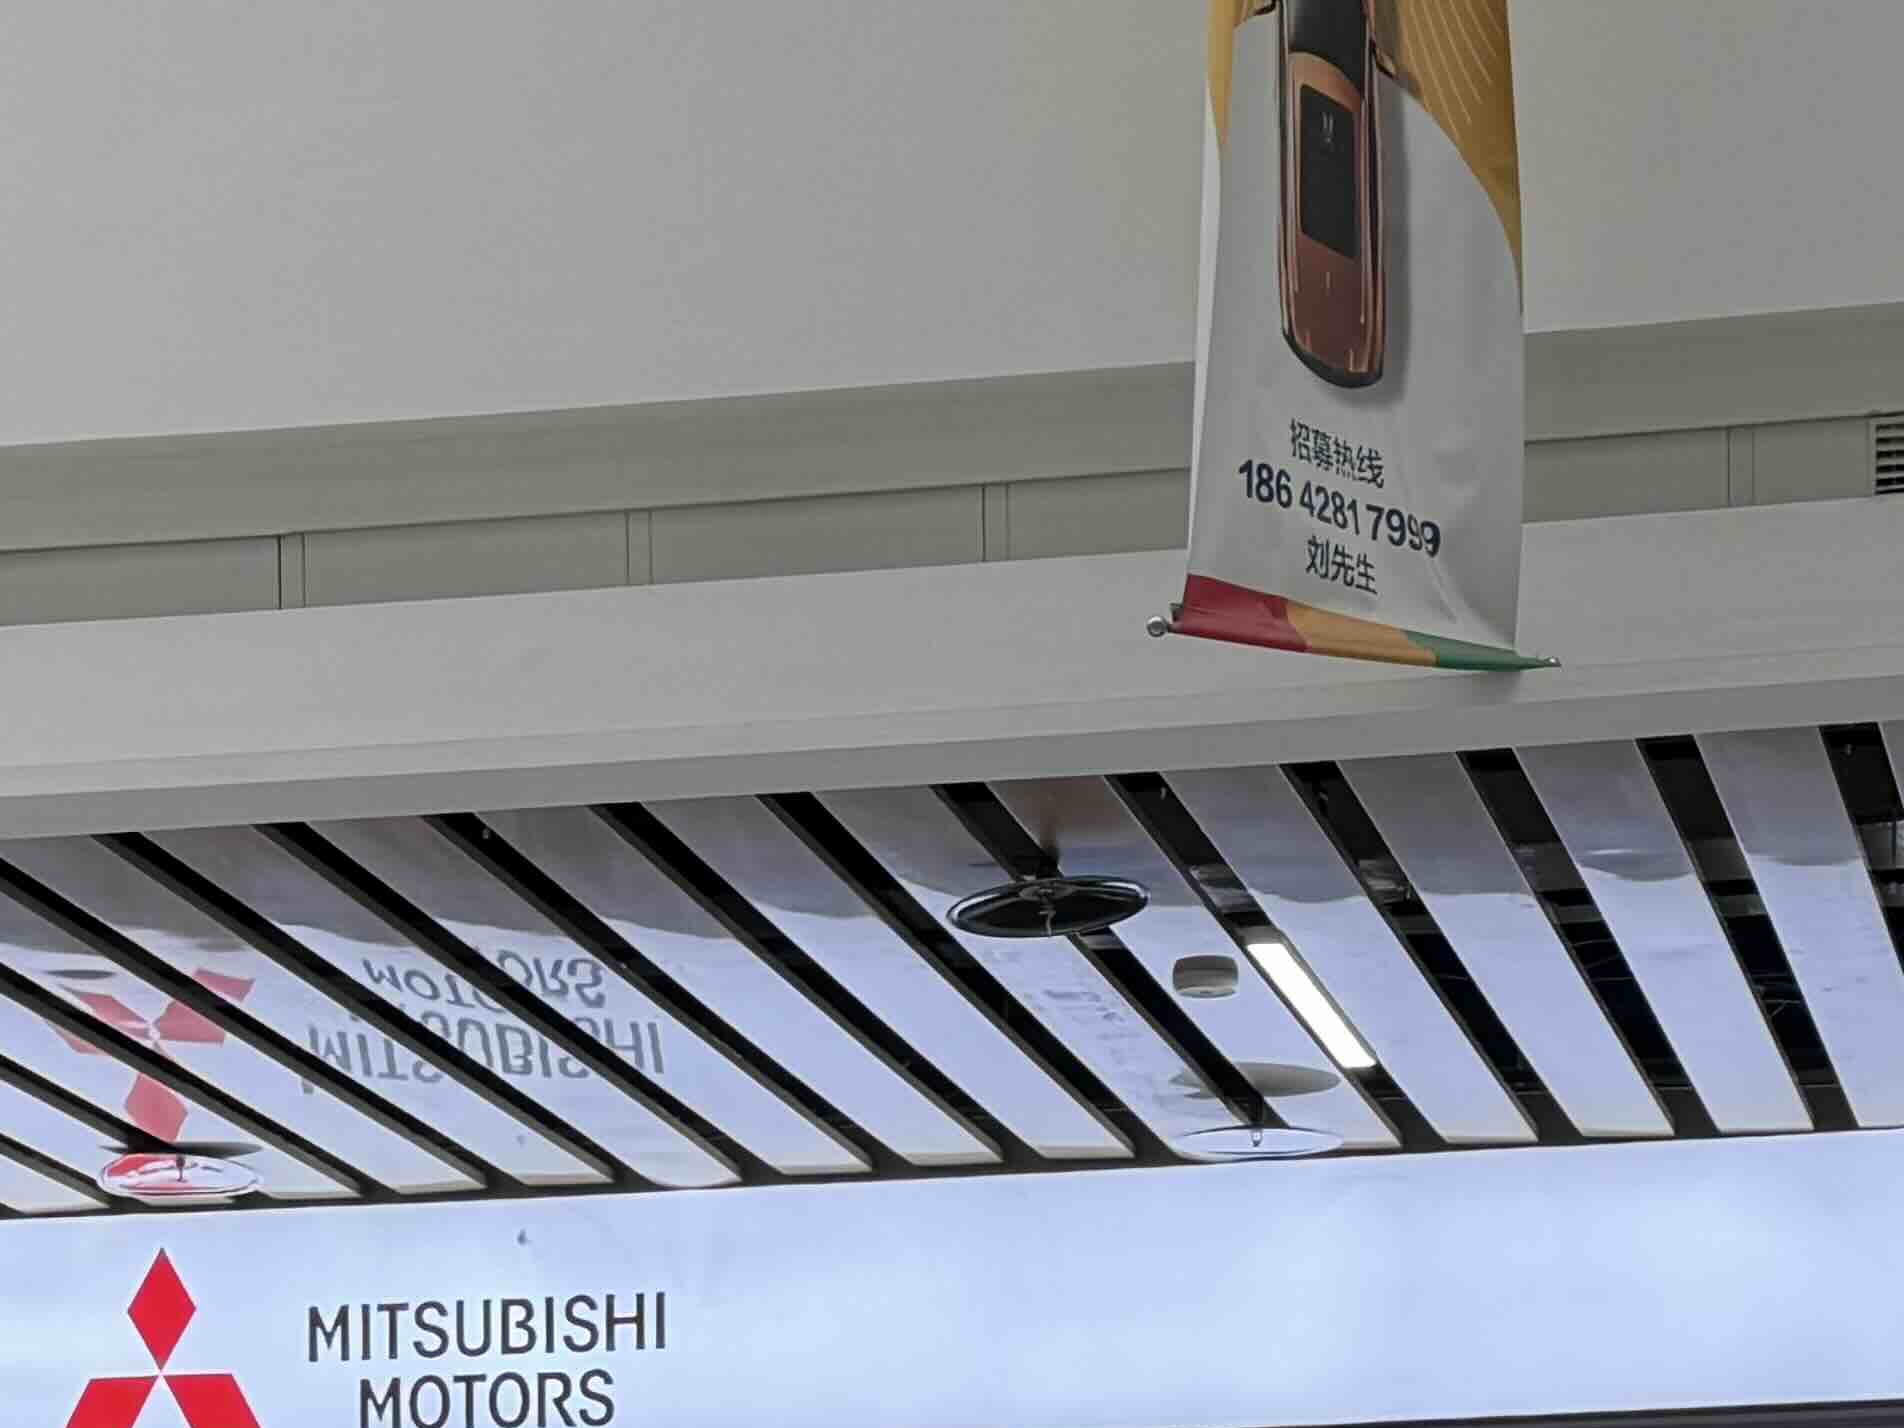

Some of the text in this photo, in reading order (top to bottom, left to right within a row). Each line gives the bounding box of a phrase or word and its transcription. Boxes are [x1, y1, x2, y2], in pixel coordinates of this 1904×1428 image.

[1289, 417, 1386, 489] 招募热线
[1238, 458, 1442, 557] 186 4281 7999
[1305, 535, 1378, 595] 刘先生
[307, 1291, 667, 1363] MITSUBISHI
